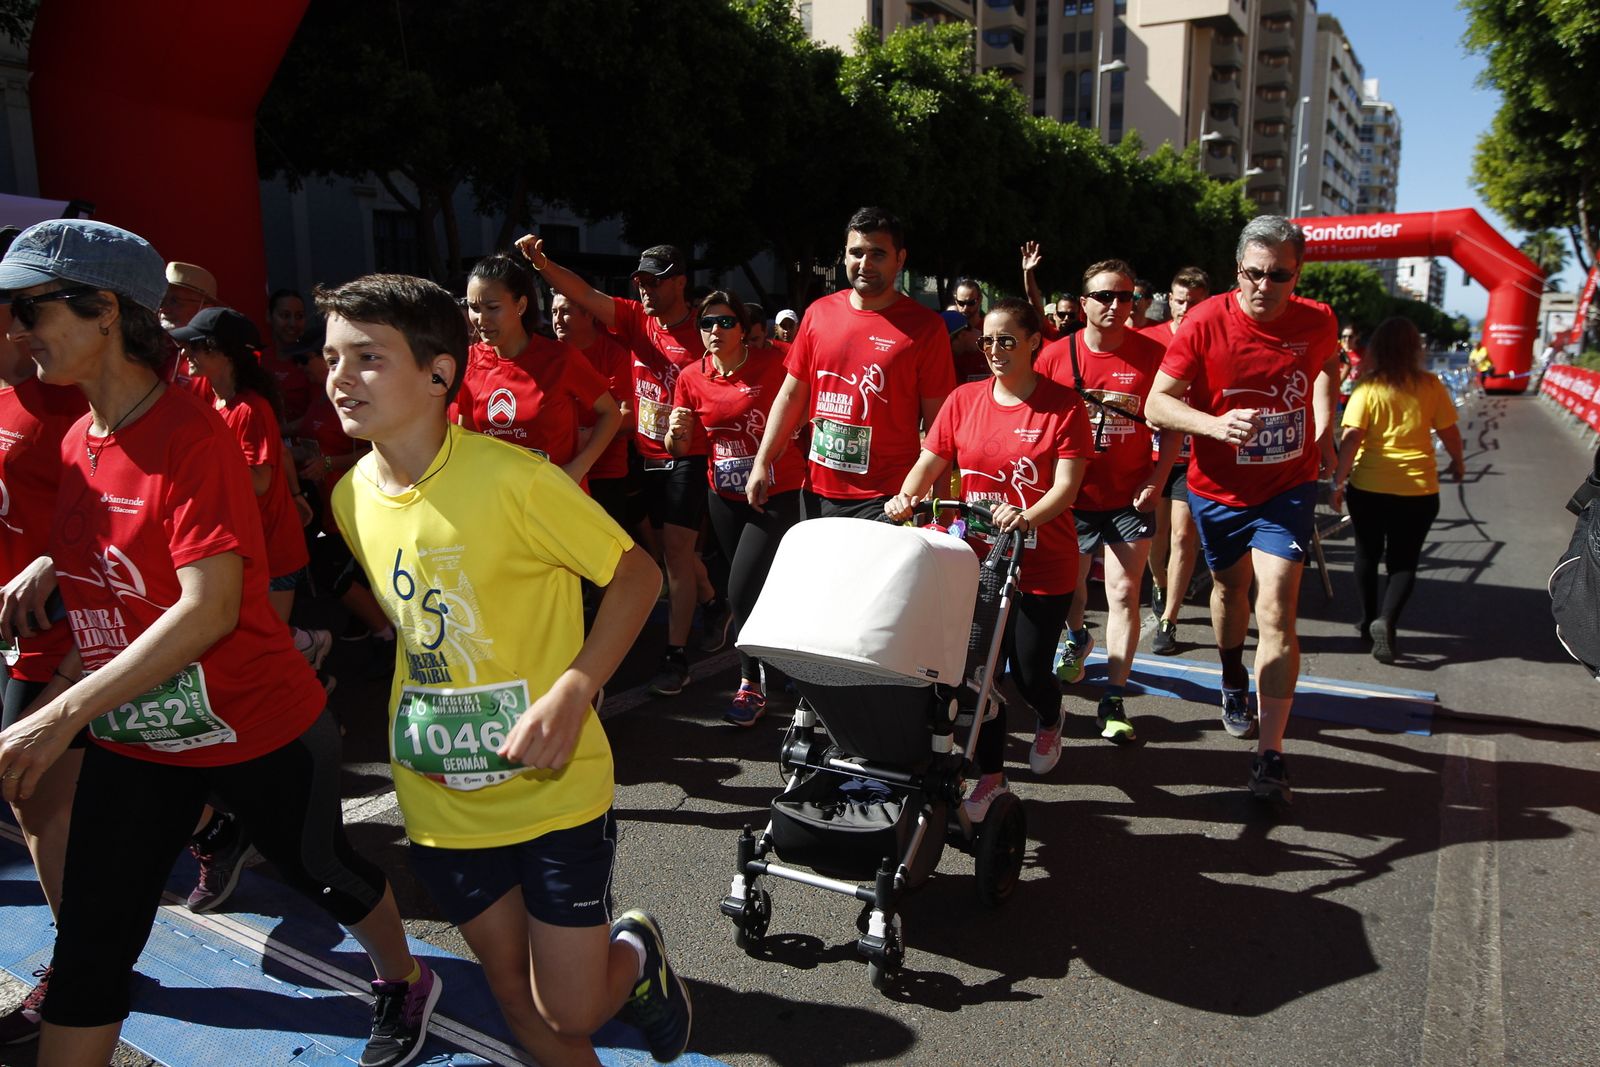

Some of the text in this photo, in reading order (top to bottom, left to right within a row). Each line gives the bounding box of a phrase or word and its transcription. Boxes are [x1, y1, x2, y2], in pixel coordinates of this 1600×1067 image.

[1302, 222, 1402, 242] Santander
[642, 410, 670, 427] 314
[818, 432, 859, 455] 1305
[1245, 427, 1296, 447] 2019
[720, 471, 751, 487] 201
[108, 494, 144, 506] Santander
[965, 490, 1009, 503] ARRERA
[101, 698, 195, 732] 1252
[139, 728, 181, 741] BEGOÑA
[404, 720, 506, 756] 1046
[443, 754, 488, 772] GERMÁN
